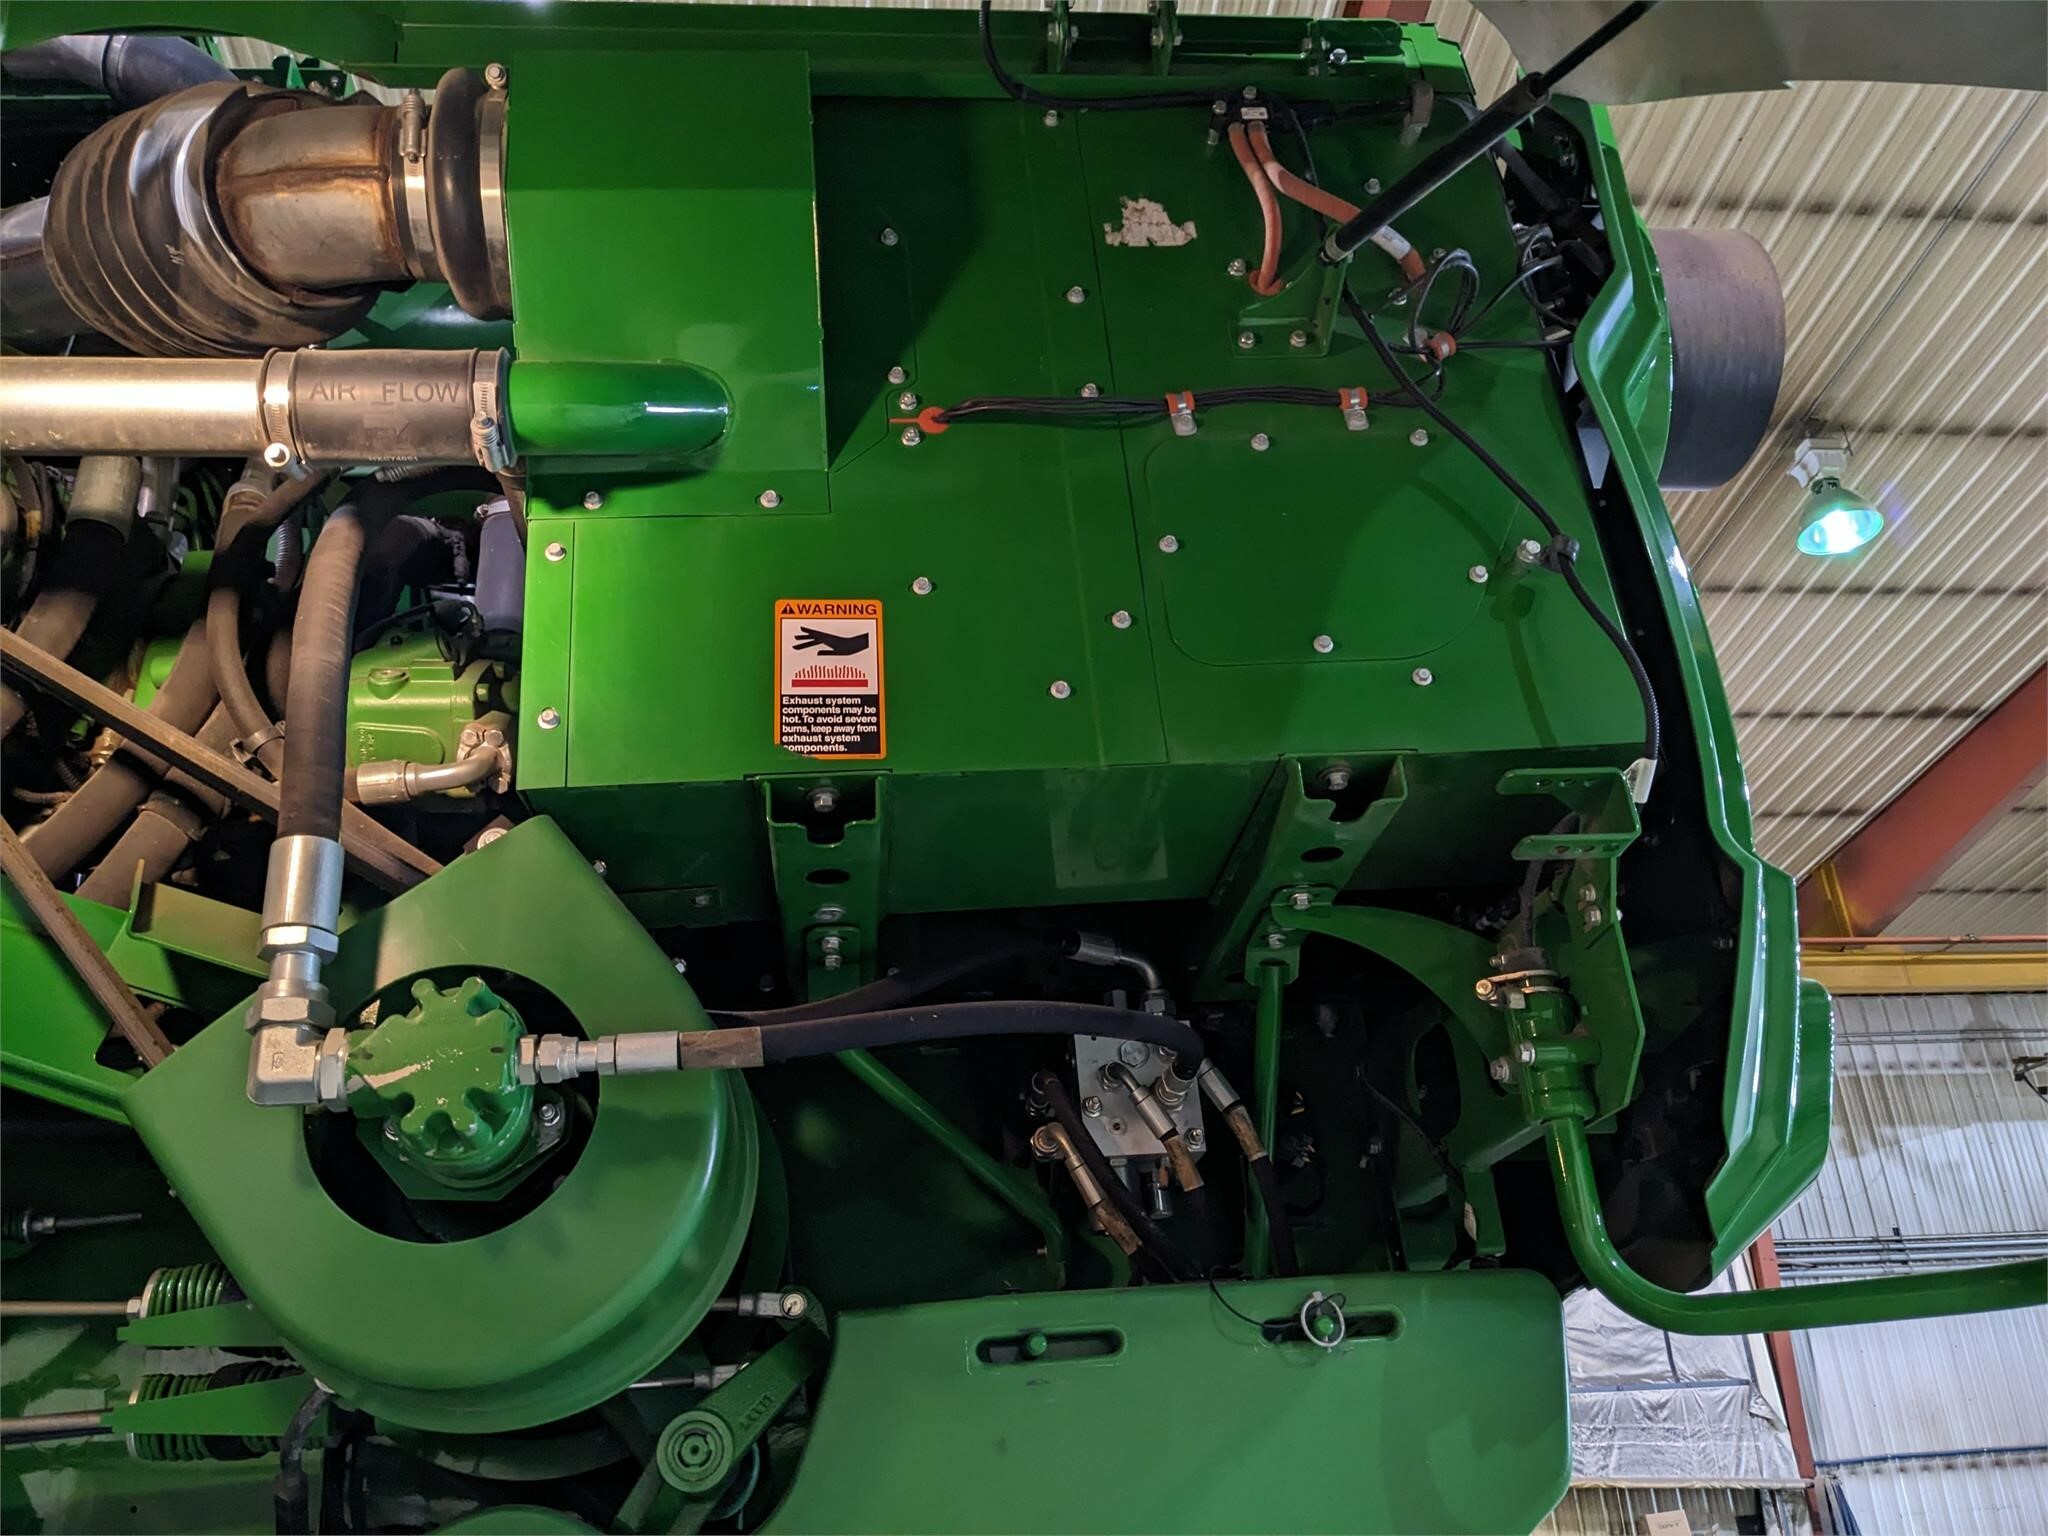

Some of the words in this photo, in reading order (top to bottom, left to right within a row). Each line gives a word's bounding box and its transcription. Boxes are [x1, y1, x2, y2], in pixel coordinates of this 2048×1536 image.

[309, 380, 357, 401] AIR
[381, 381, 461, 403] FLOW
[797, 603, 877, 615] WARNING
[782, 696, 823, 705] Exhaust
[825, 697, 861, 707] system
[782, 706, 841, 715] components
[843, 706, 862, 715] may
[864, 705, 877, 715] be
[782, 715, 802, 724] hot.
[803, 715, 815, 724] To
[816, 715, 843, 724] avoid
[845, 715, 877, 724] severe
[782, 724, 810, 734] burns,
[811, 724, 831, 734] keep
[833, 725, 856, 734] away
[857, 724, 877, 734] from
[782, 734, 823, 743] exhaust
[824, 734, 861, 744] system
